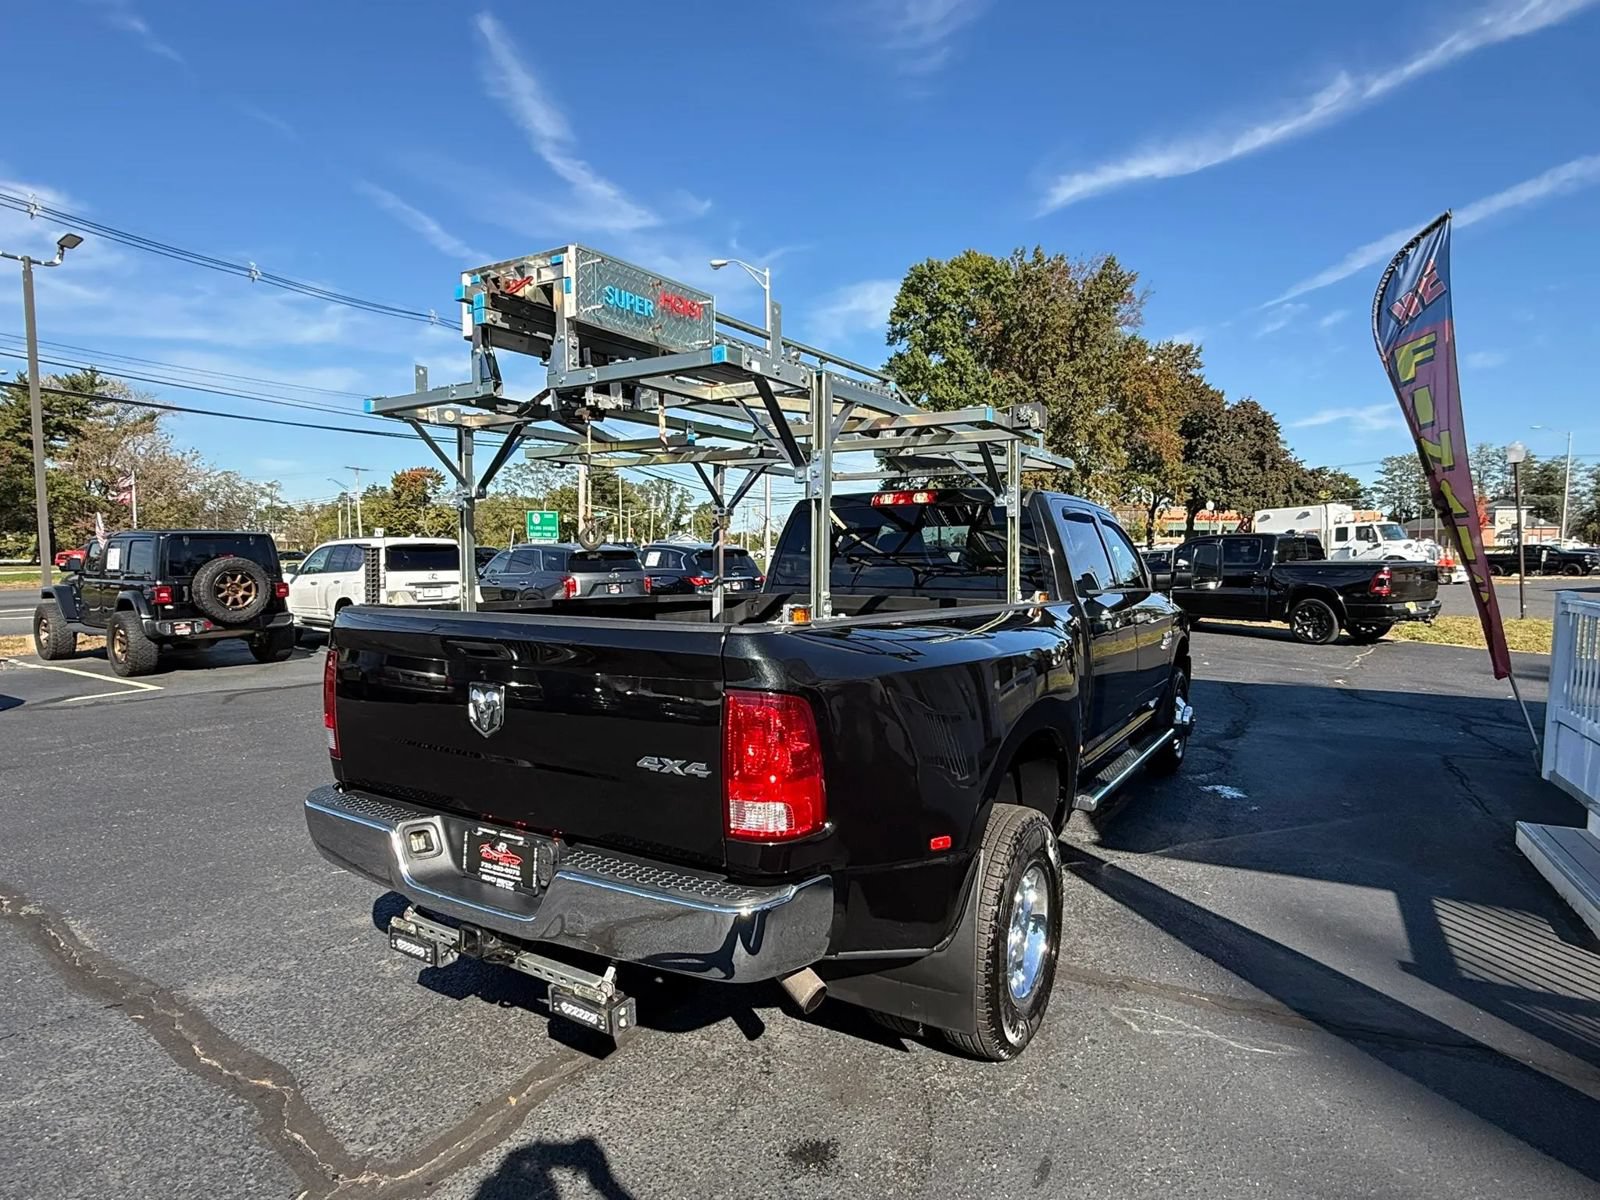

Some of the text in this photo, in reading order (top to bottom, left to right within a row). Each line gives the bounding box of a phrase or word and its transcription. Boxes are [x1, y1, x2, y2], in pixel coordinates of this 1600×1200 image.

[602, 285, 704, 321] SUPER HOIST
[1390, 259, 1447, 325] WE
